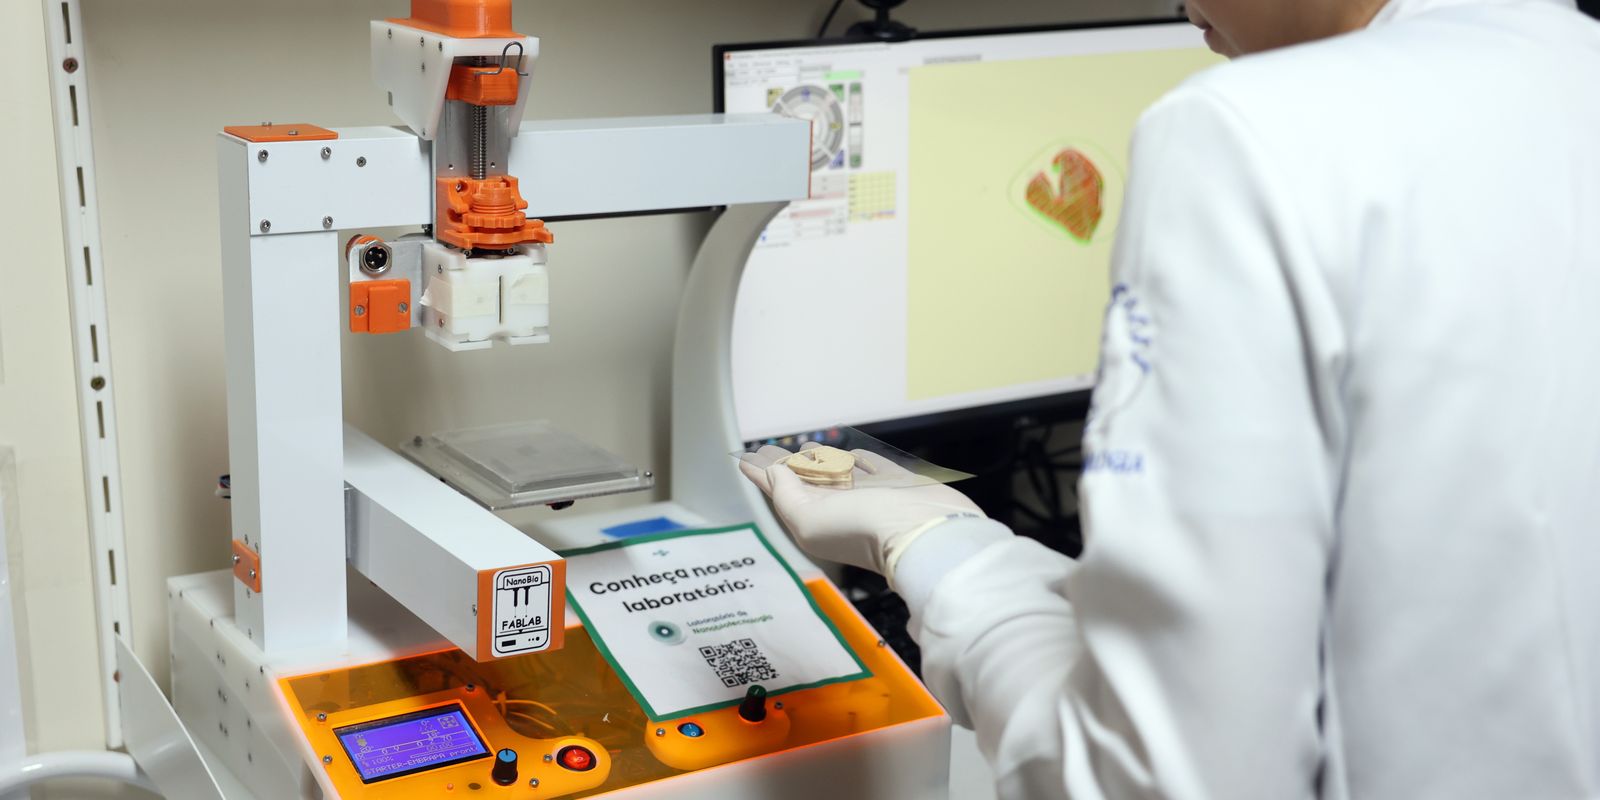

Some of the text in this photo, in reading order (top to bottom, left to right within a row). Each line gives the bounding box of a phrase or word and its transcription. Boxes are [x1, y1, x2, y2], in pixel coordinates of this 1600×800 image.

[506, 575, 539, 587] NanoBio
[589, 556, 756, 595] Conheça nosso
[622, 578, 755, 613] laboratório:
[501, 615, 542, 631] FABLAB
[365, 753, 445, 774] STARTER-EMBRAPA
